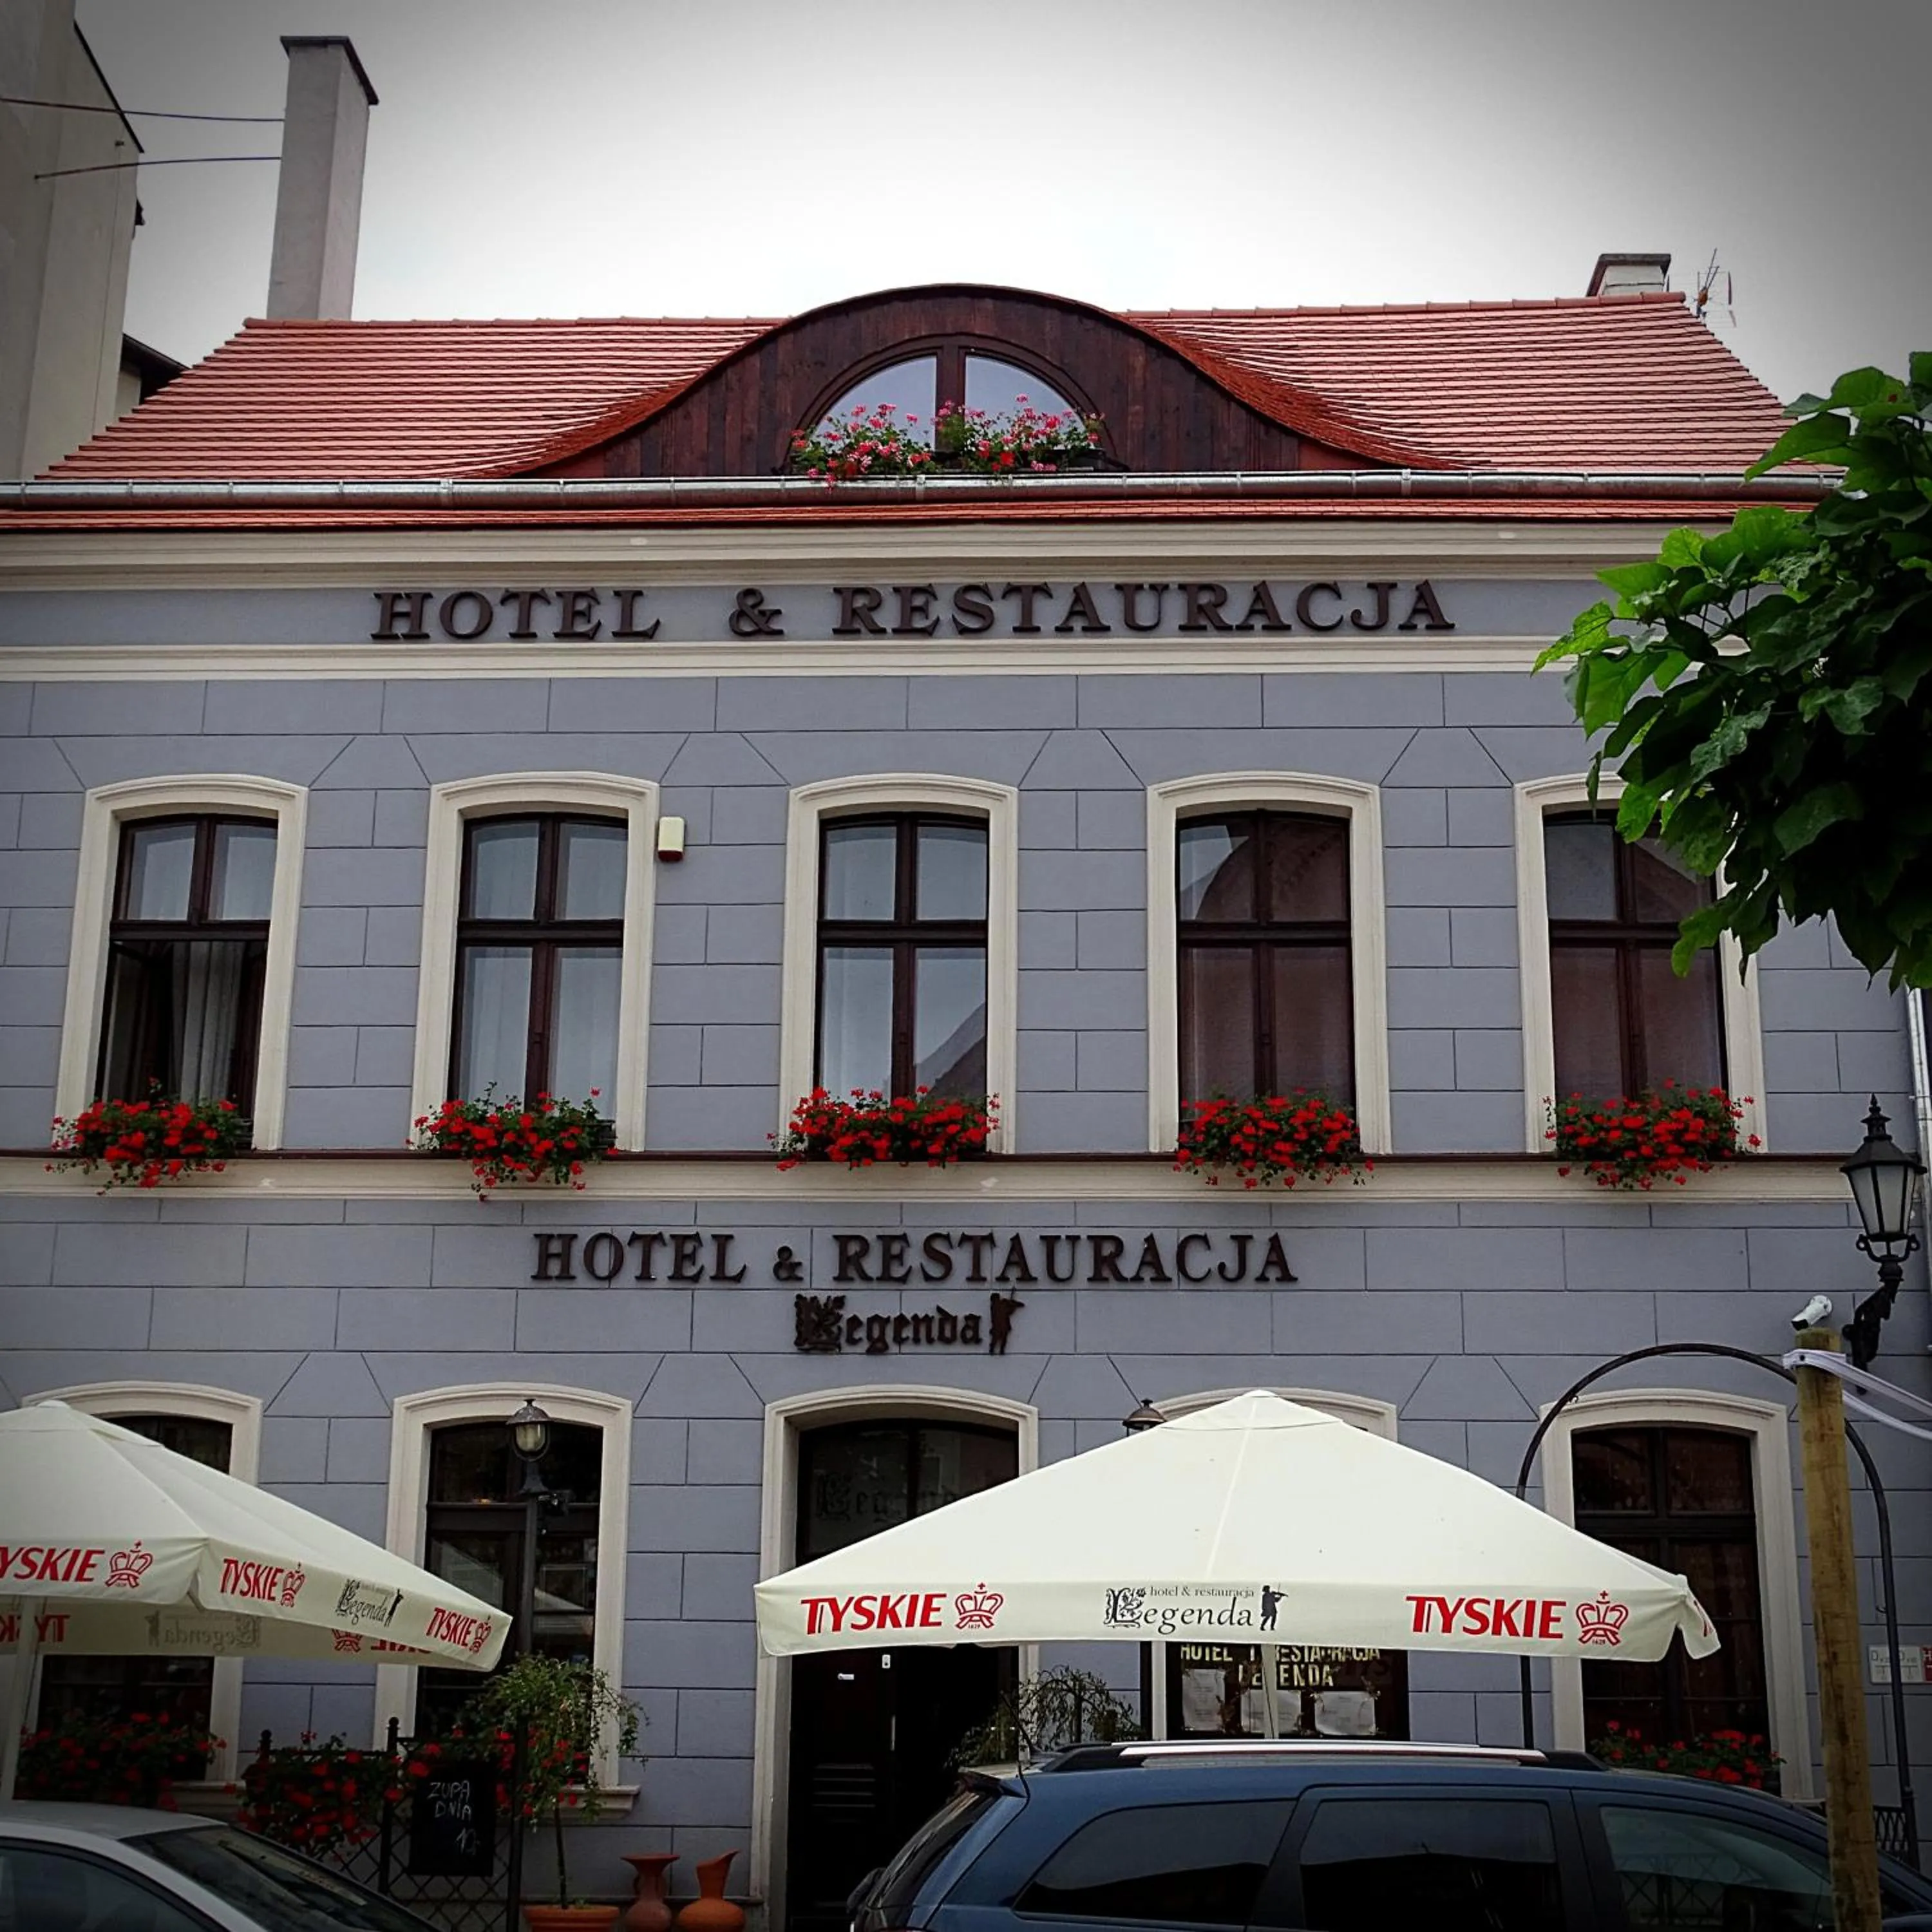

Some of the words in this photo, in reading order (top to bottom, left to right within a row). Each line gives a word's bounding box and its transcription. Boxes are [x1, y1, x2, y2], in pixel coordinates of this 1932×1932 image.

[371, 587, 661, 639] HOTEL
[728, 587, 784, 637] &
[831, 579, 1455, 637] RESTAURACJA
[530, 1231, 747, 1283] HOTEL
[773, 1245, 804, 1281] &
[832, 1231, 1299, 1282] RESTAURACJA
[794, 1293, 982, 1354] Legenda
[0, 1546, 105, 1582] YSKIE
[220, 1558, 284, 1602] TYSKIE
[1103, 1587, 1253, 1634] Legenda
[1150, 1586, 1178, 1596] hotel
[426, 1607, 477, 1646] TYSKIE
[800, 1593, 947, 1635] TYSKIE
[1406, 1595, 1567, 1639] TYSKIE
[427, 1780, 470, 1803] ZUPA
